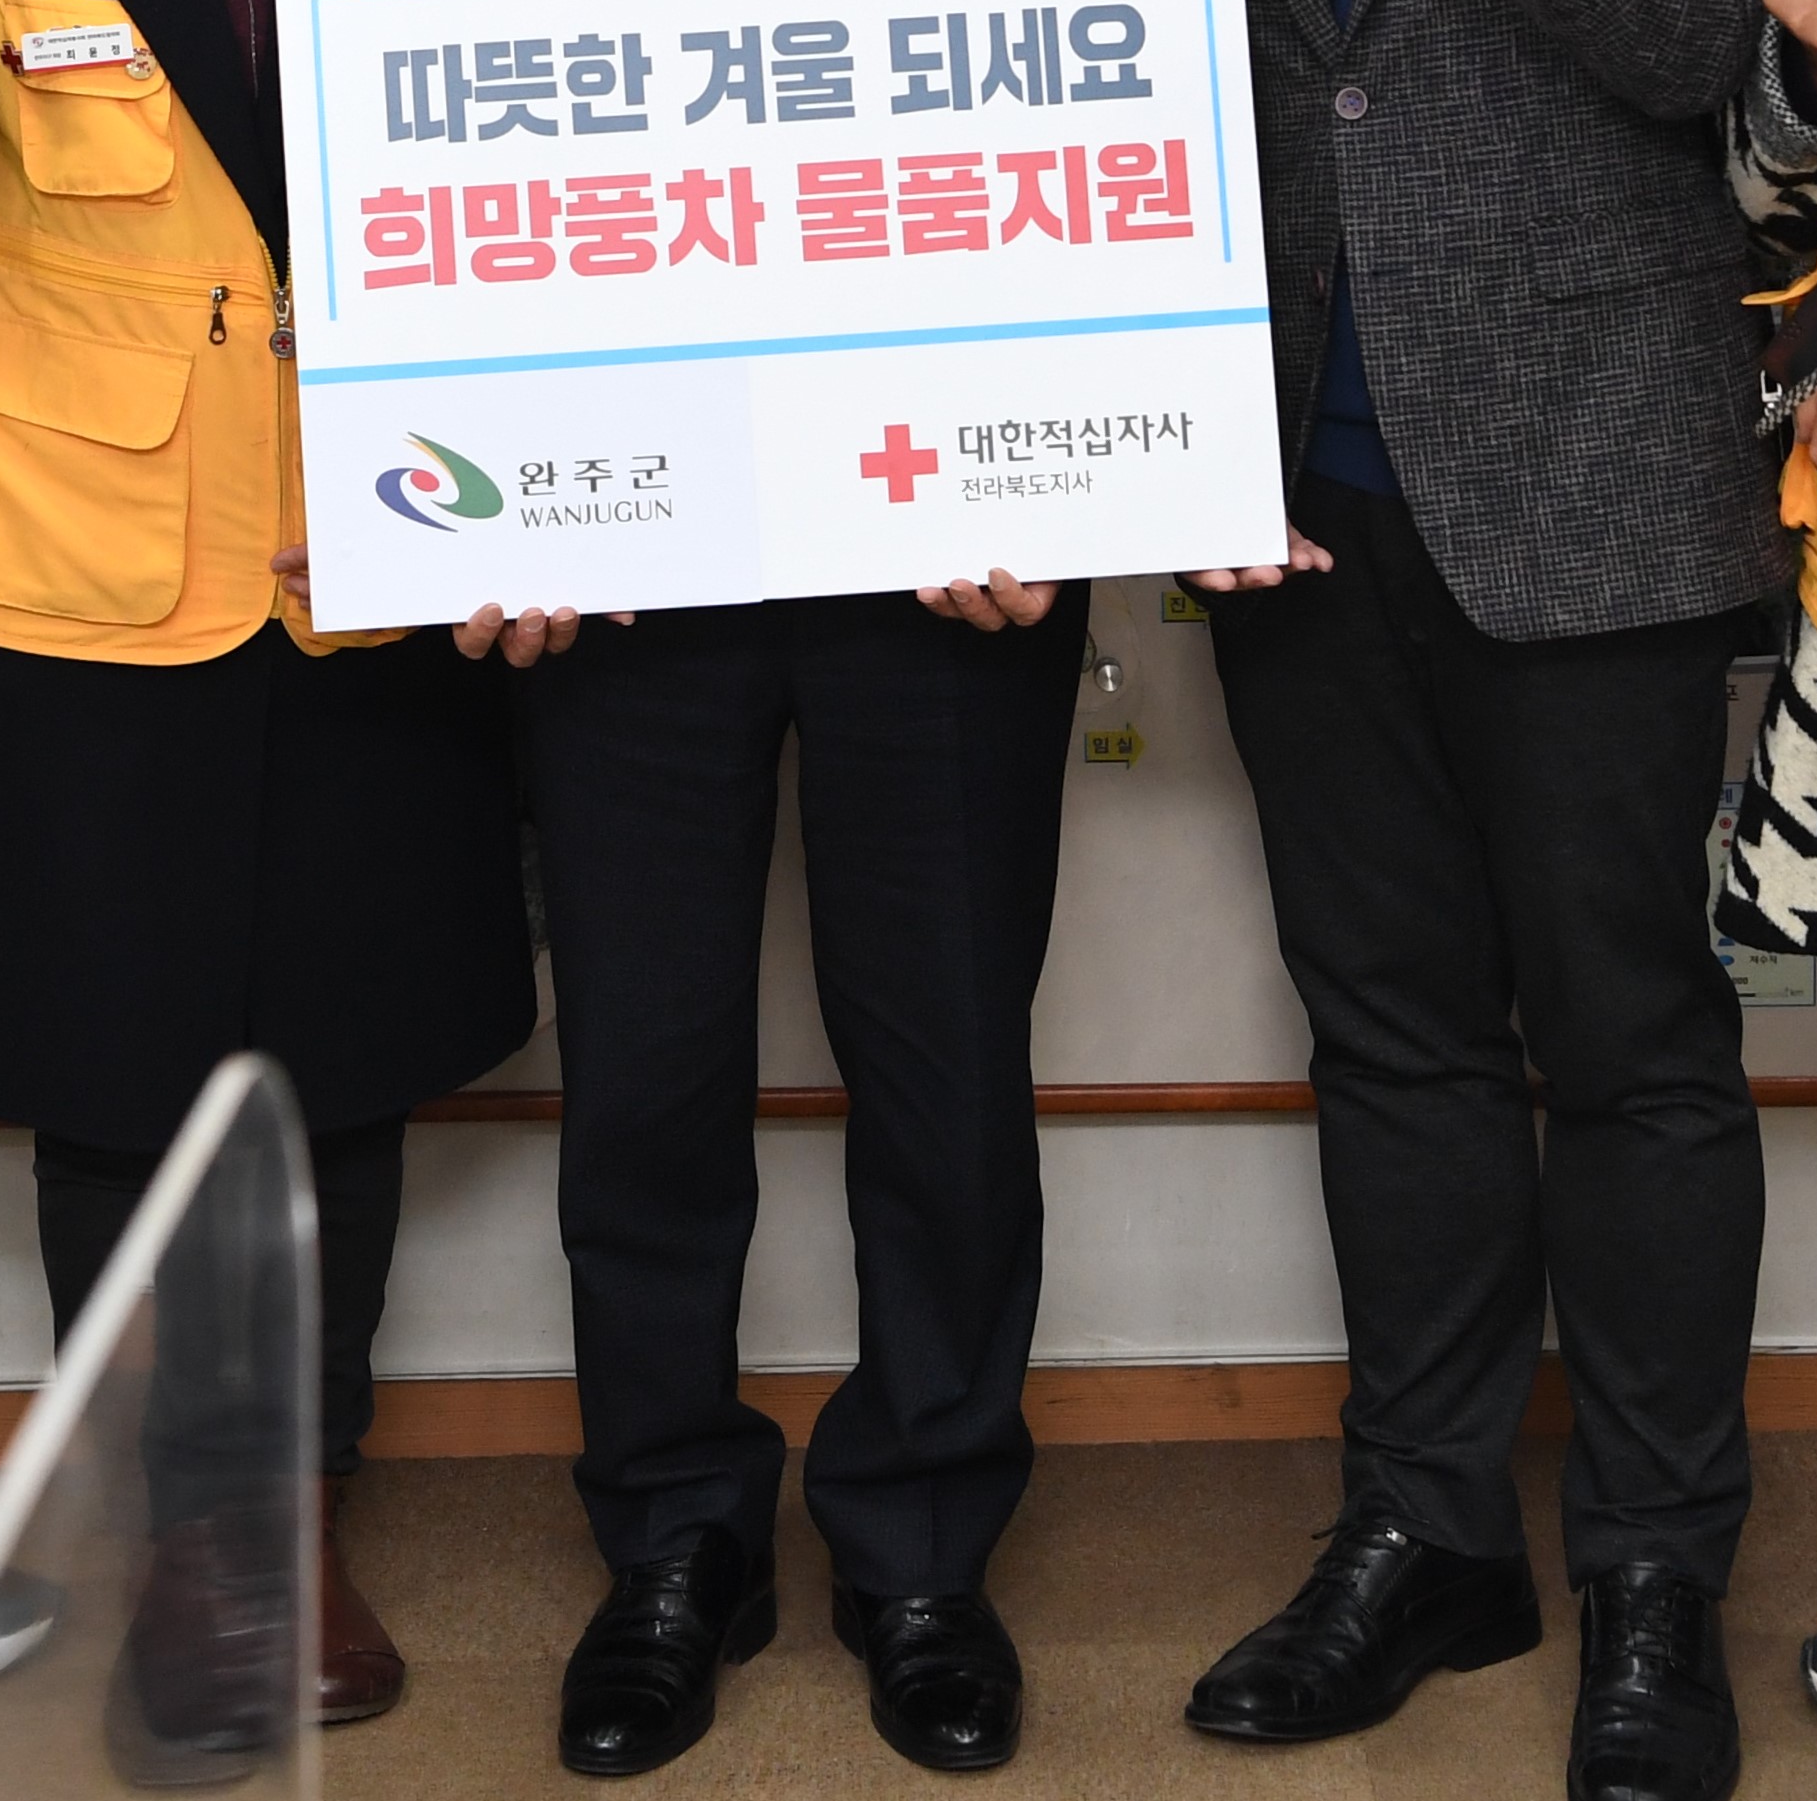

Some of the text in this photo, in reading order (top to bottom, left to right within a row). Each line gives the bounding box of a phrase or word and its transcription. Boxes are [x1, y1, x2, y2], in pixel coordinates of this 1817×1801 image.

[382, 3, 1153, 144] 따뜻한 겨울 되세요
[359, 138, 1194, 291] 희망풍차 물품지원
[957, 410, 1192, 462] 대한적십자사
[518, 455, 670, 494] 완주군
[960, 470, 1093, 500] 전라북도지사
[519, 498, 673, 530] WANJUGUN
